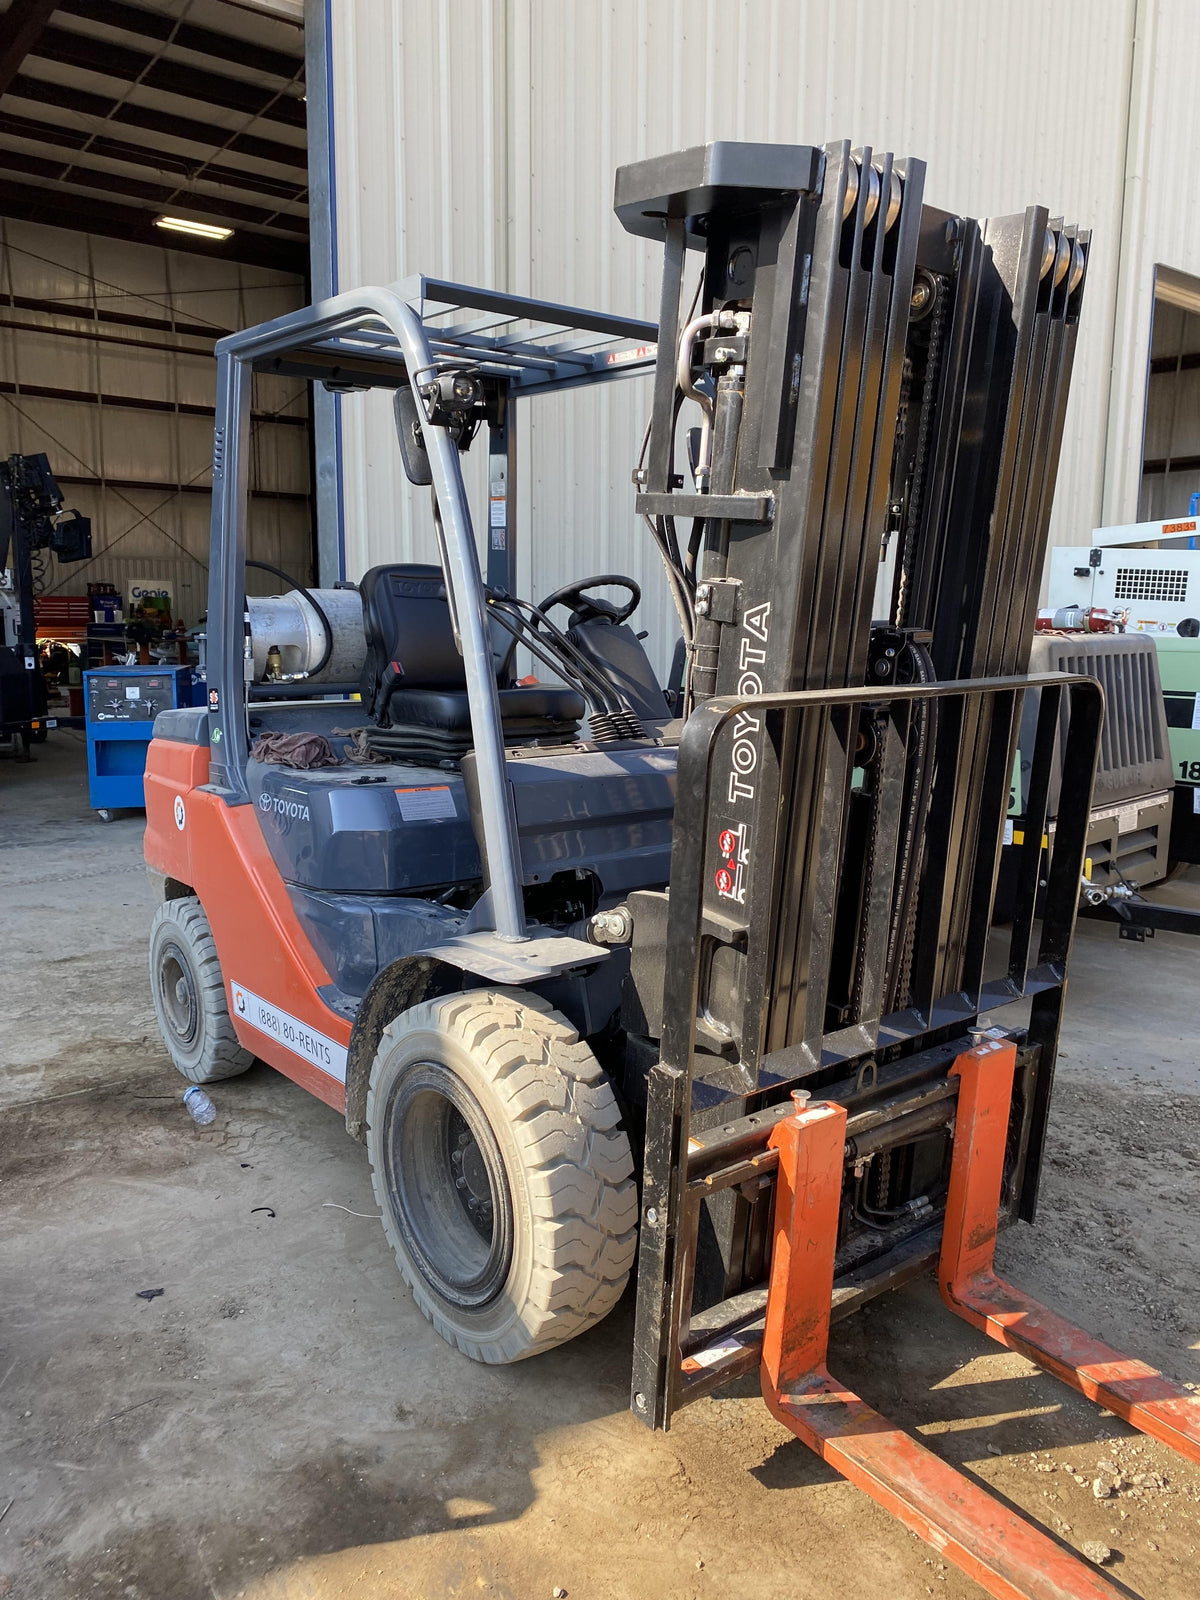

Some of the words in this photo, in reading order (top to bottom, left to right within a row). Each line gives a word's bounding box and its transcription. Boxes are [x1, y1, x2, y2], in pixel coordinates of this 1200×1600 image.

[1163, 522, 1196, 533] 73839
[131, 586, 169, 599] Genie
[728, 601, 771, 804] TOYOTA
[273, 798, 310, 822] TOYOTA
[258, 1006, 281, 1036] (888)
[283, 1022, 331, 1065] 80-RENTS
